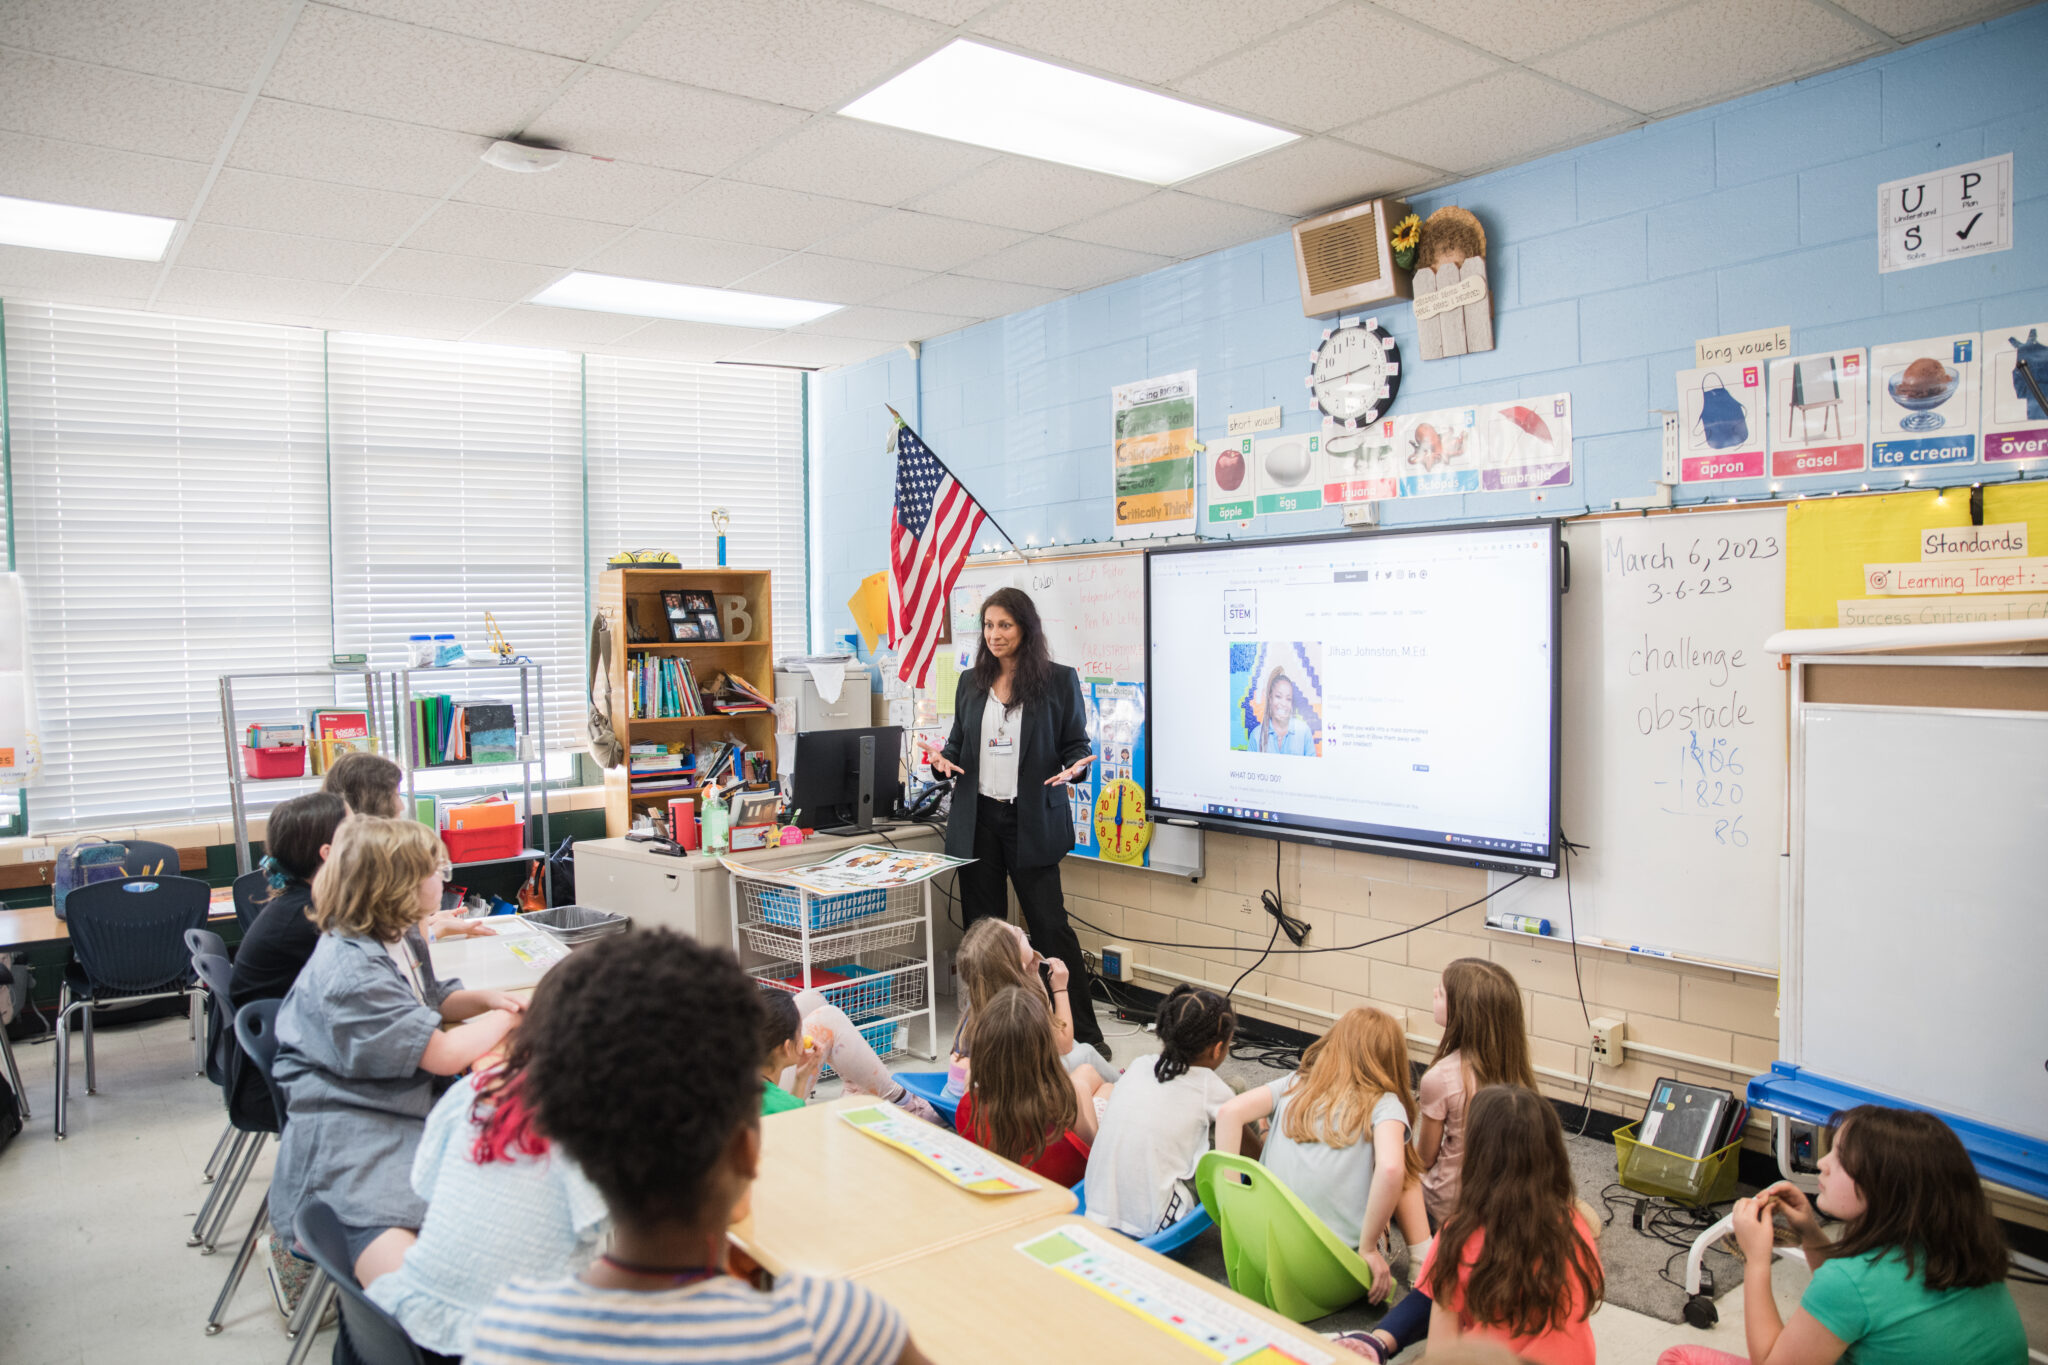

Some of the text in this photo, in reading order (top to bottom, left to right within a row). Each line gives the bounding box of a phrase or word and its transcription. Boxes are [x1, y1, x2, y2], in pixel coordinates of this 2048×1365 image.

[1960, 172, 1982, 200] P
[1901, 184, 1926, 213] U
[1962, 200, 1979, 209] Plan
[1894, 208, 1937, 223] Understand
[1904, 225, 1922, 251] S
[1906, 252, 1927, 261] Solve
[1346, 336, 1355, 347] 12
[1701, 333, 1787, 363] long vowels
[1333, 343, 1342, 354] 11
[1325, 358, 1335, 368] 10
[1229, 416, 1252, 432] short
[1116, 442, 1180, 462] Collaborate
[1910, 446, 1968, 461] cream
[1116, 500, 1193, 520] Critically Think
[1924, 530, 2024, 555] Standards
[1606, 536, 1779, 576] March 6, 2023
[1897, 569, 1965, 595] Learning
[1647, 576, 1732, 604] 3-6-23
[723, 595, 752, 642] B
[1229, 609, 1251, 619] STEM
[1845, 607, 1912, 626] Success
[1327, 646, 1352, 657] Jihan
[1628, 633, 1746, 688] challenge
[1084, 661, 1112, 674] TECH
[1638, 690, 1755, 735] obstacle
[1230, 771, 1282, 783] WHAT DO YOU DO?
[1109, 789, 1116, 800] 11
[1130, 790, 1134, 801] 1
[1101, 800, 1110, 811] 10
[1135, 801, 1142, 813] 2
[1138, 818, 1144, 829] 3
[1100, 826, 1106, 837] 8
[1134, 832, 1139, 843] 4
[1107, 838, 1113, 848] 7
[1125, 841, 1131, 852] 5
